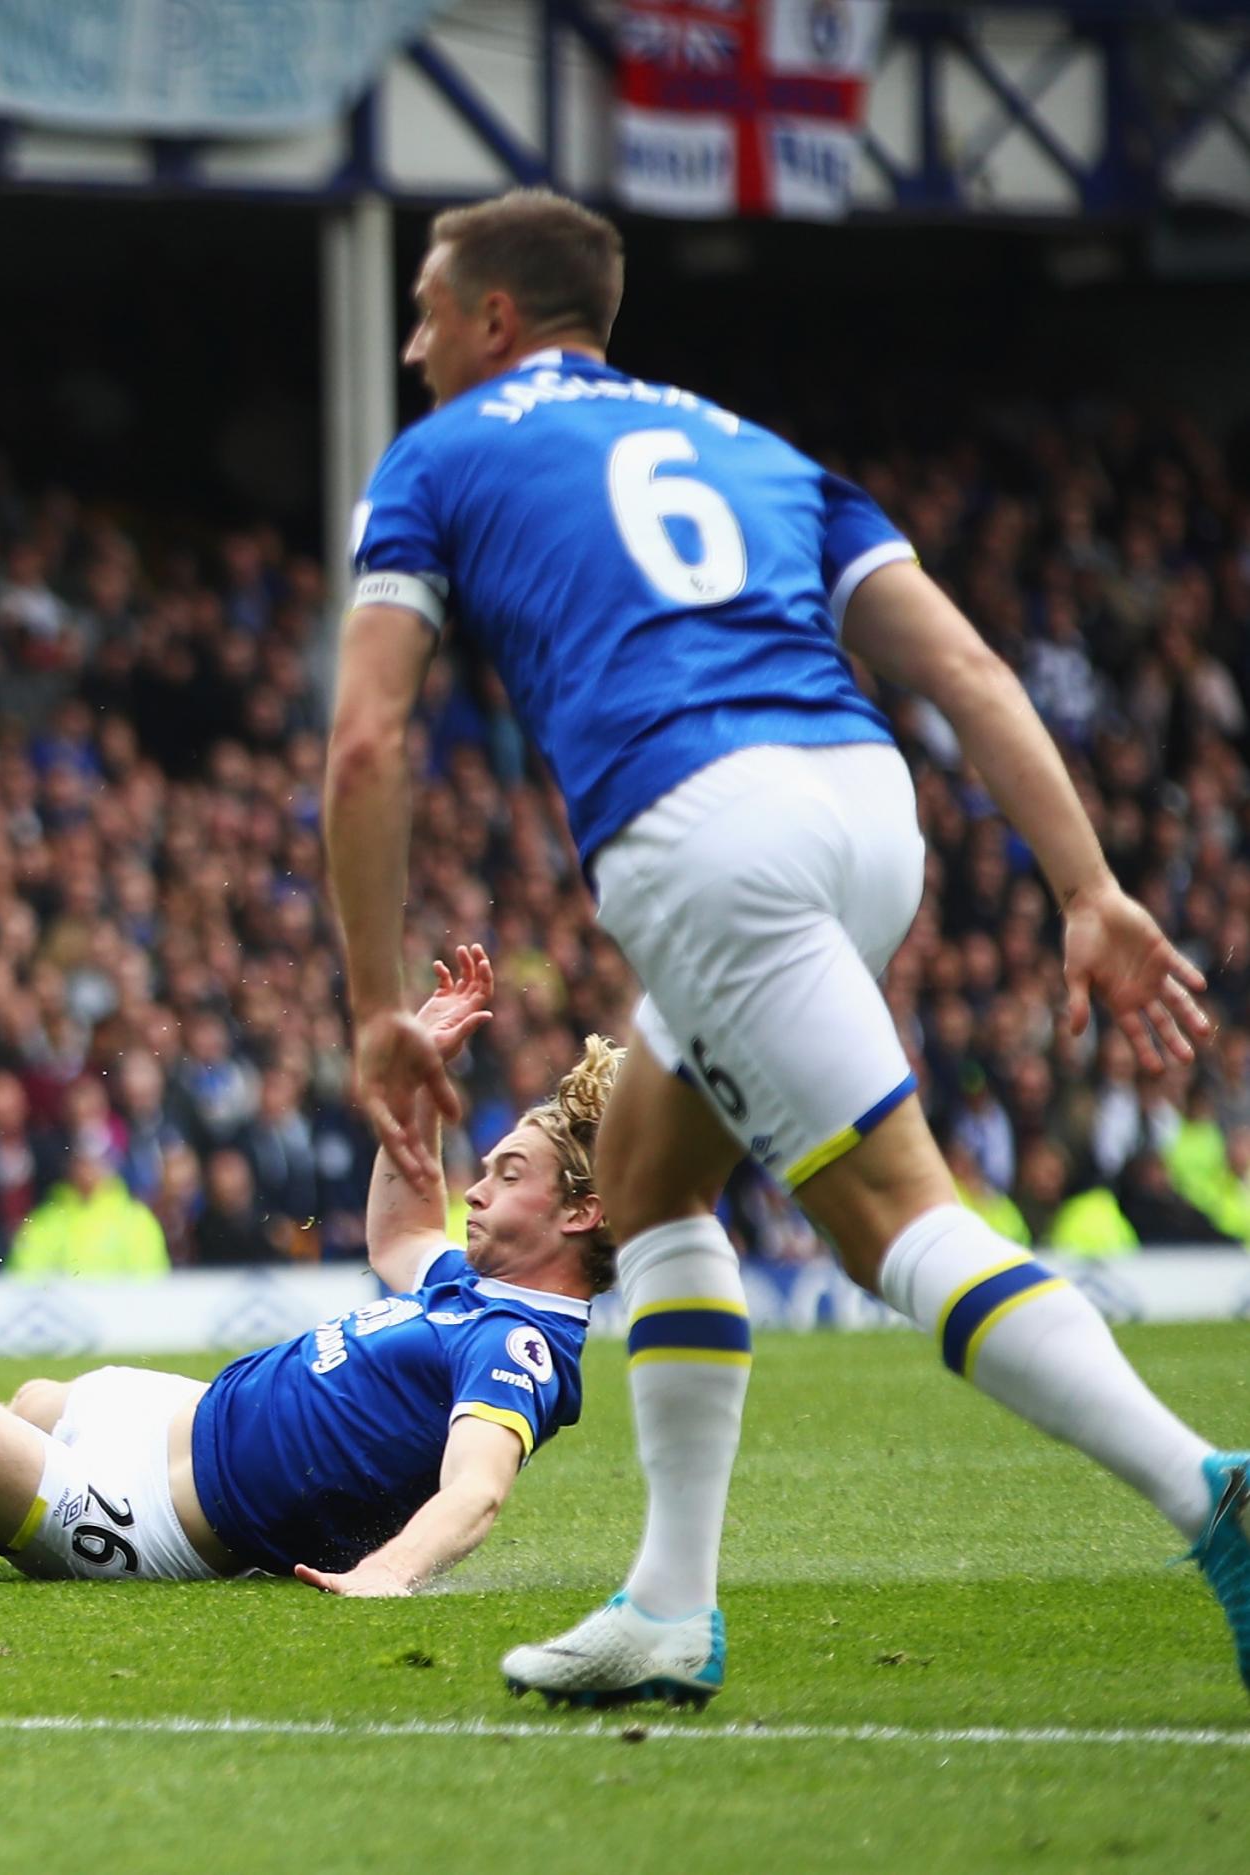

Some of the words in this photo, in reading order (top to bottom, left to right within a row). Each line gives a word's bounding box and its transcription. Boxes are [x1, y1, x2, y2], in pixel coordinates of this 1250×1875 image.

[607, 429, 748, 606] 6
[691, 1034, 749, 1122] 6
[71, 1484, 141, 1576] 26
